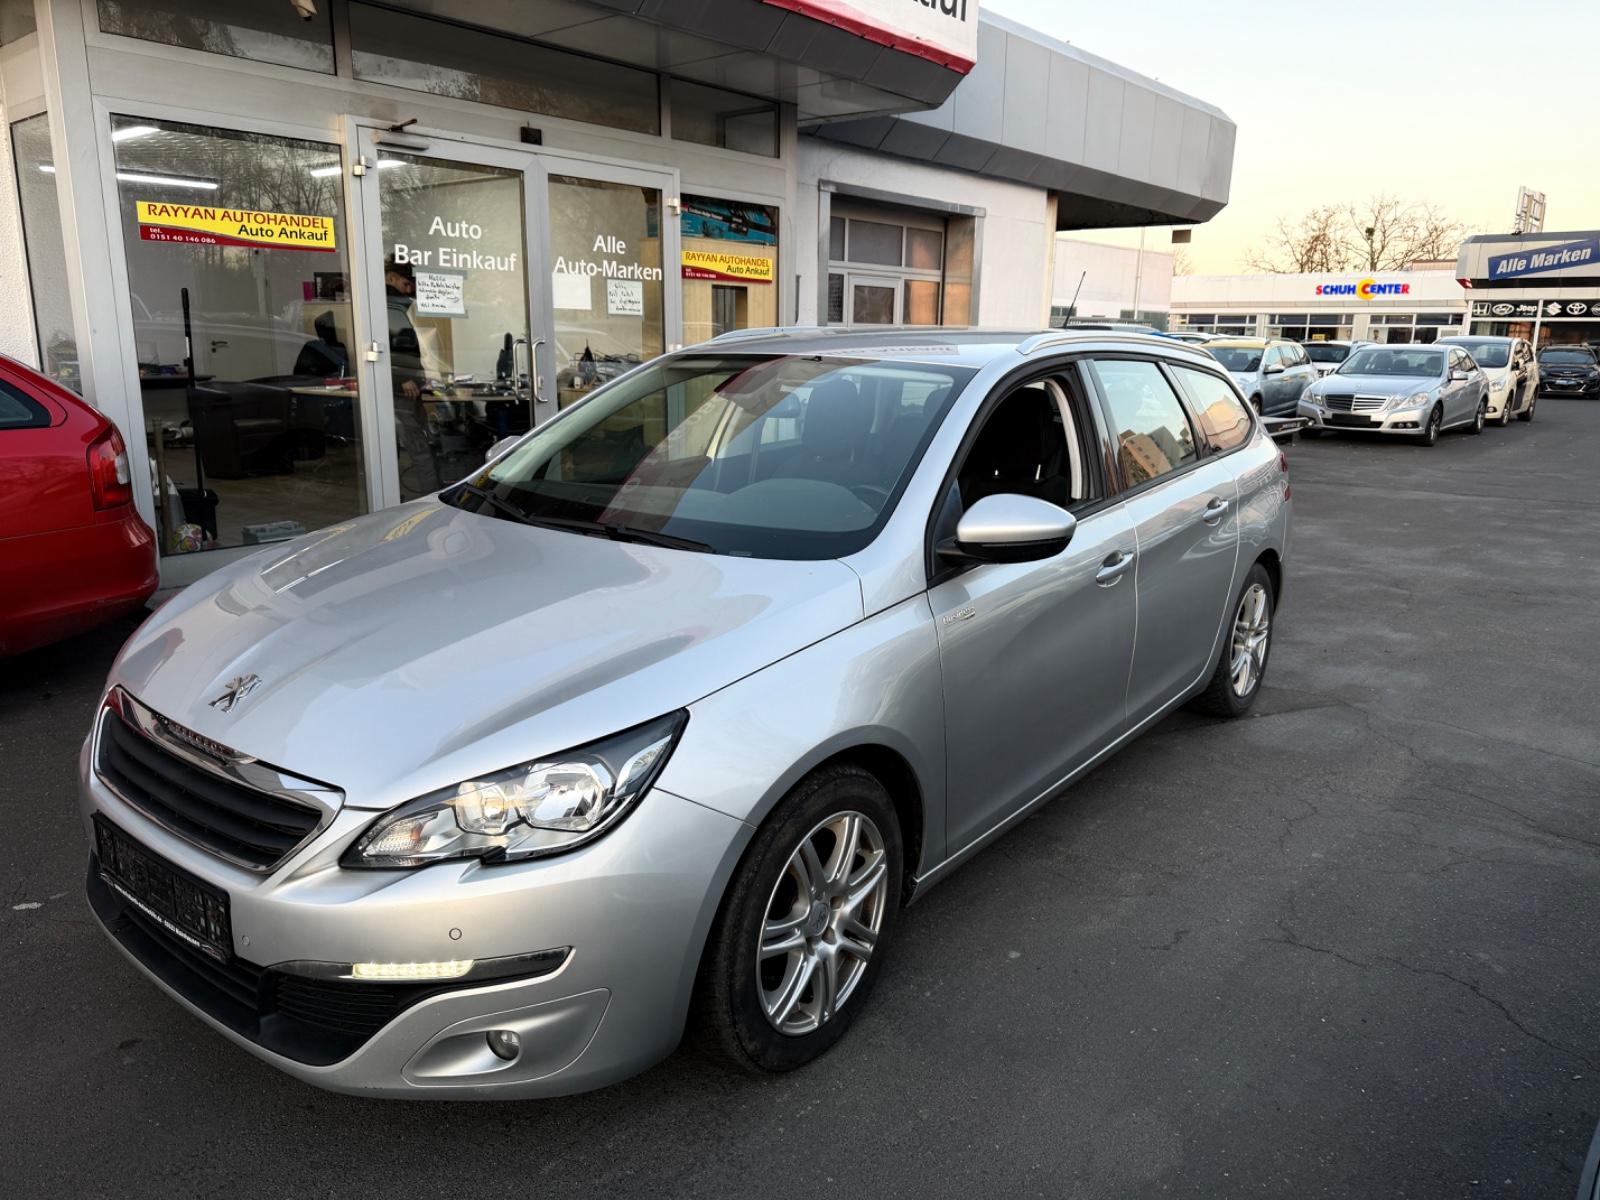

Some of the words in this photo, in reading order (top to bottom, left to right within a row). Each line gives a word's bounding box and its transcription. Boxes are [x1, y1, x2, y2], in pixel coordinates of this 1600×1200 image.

[147, 203, 216, 221] RAYYAN
[221, 210, 328, 229] AUTOHANDEL
[238, 224, 274, 238] Auto
[278, 227, 328, 241] Ankauf
[428, 215, 482, 239] Auto
[592, 234, 626, 255] Alle
[394, 243, 432, 266] Bar
[438, 247, 518, 272] Einkauf
[553, 255, 662, 281] Auto-Marken
[685, 251, 718, 262] RAYYAN
[719, 255, 770, 267] AUTOHANDEL
[1496, 257, 1527, 275] Alle
[1530, 248, 1592, 269] Marken
[726, 265, 744, 274] Auto
[745, 266, 770, 276] Ankauf
[1315, 284, 1356, 295] SCHUH
[1360, 282, 1410, 296] CENTER
[1516, 304, 1538, 313] Jeep
